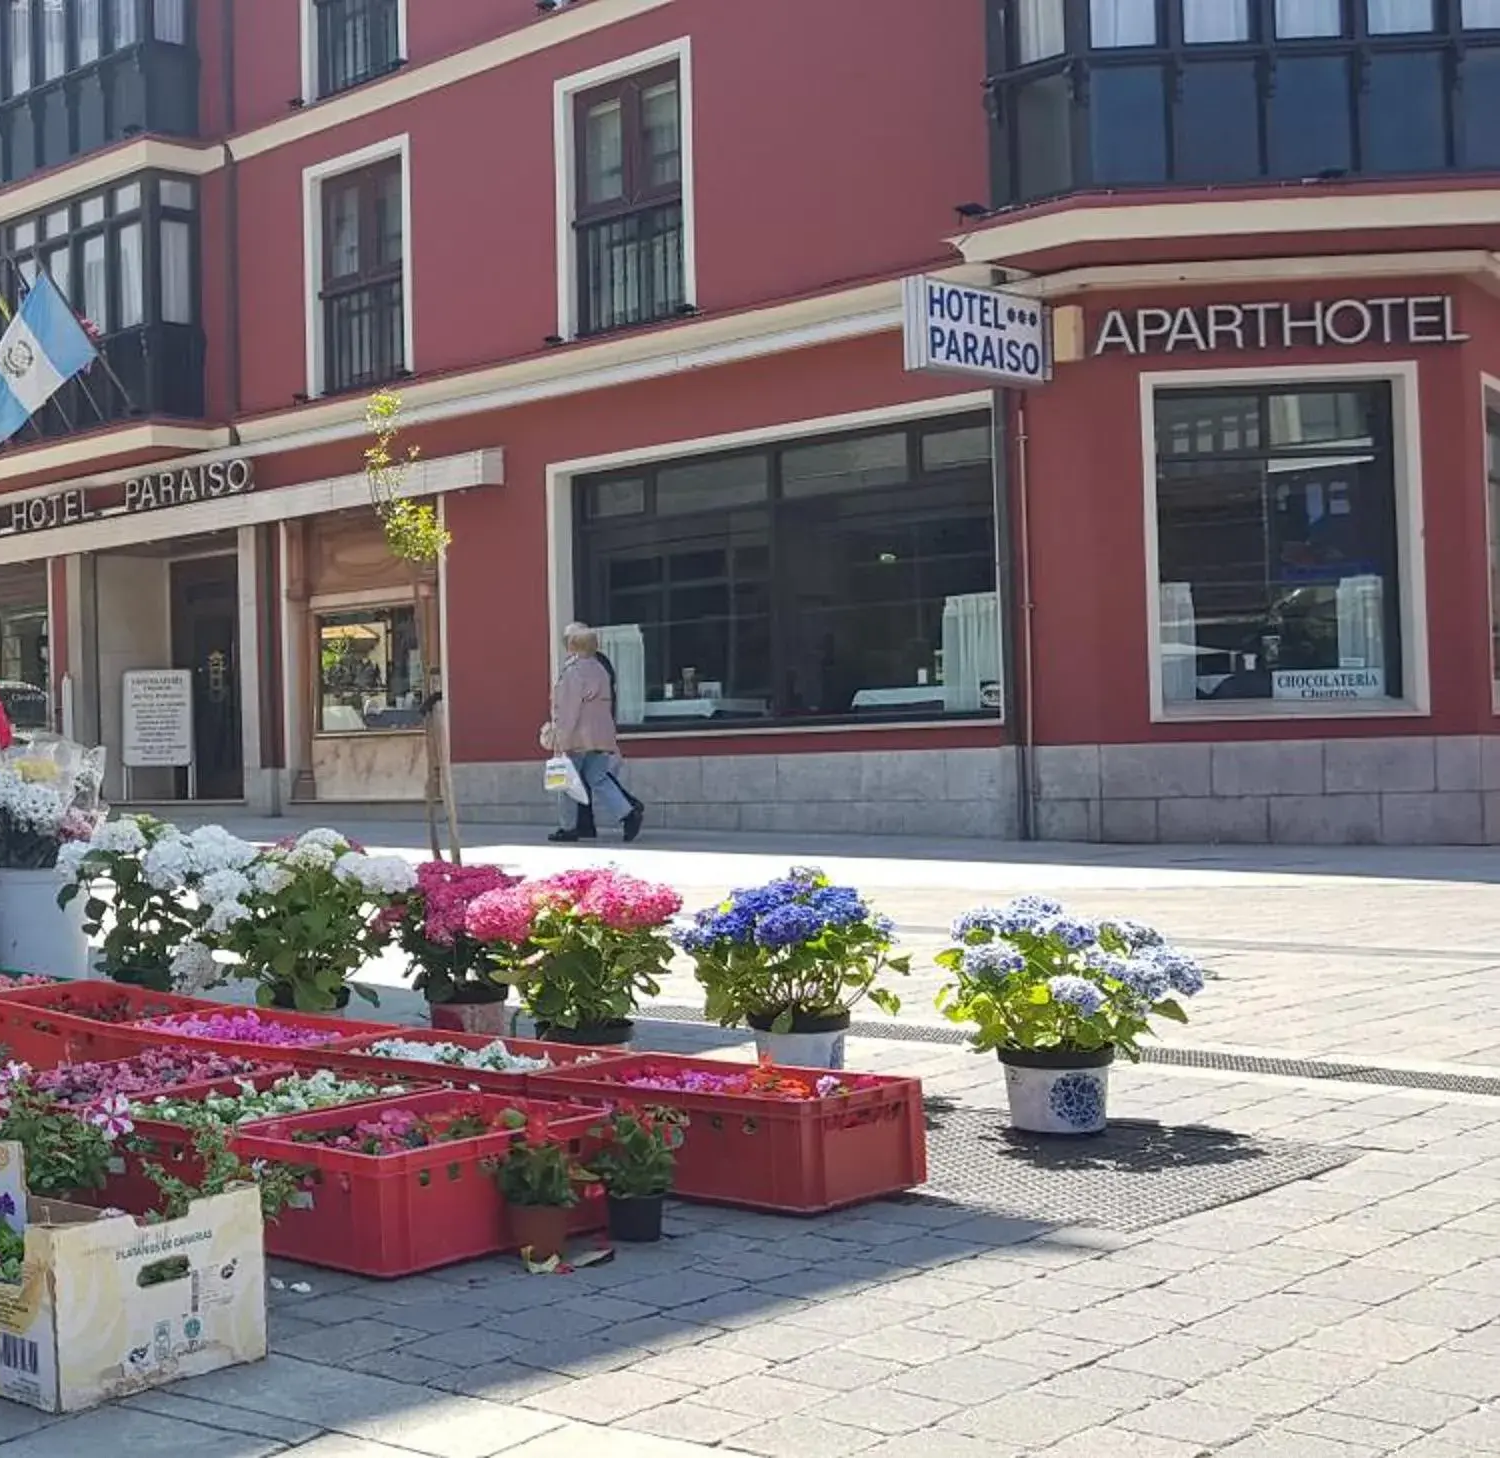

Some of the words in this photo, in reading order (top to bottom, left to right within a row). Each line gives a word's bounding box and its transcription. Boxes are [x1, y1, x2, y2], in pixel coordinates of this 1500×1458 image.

[928, 285, 1006, 331] HOTEL
[1095, 296, 1470, 355] APARTHOTEL
[930, 326, 1040, 375] PARAISO
[11, 487, 95, 531] HOTEL
[125, 458, 249, 512] PARAISO
